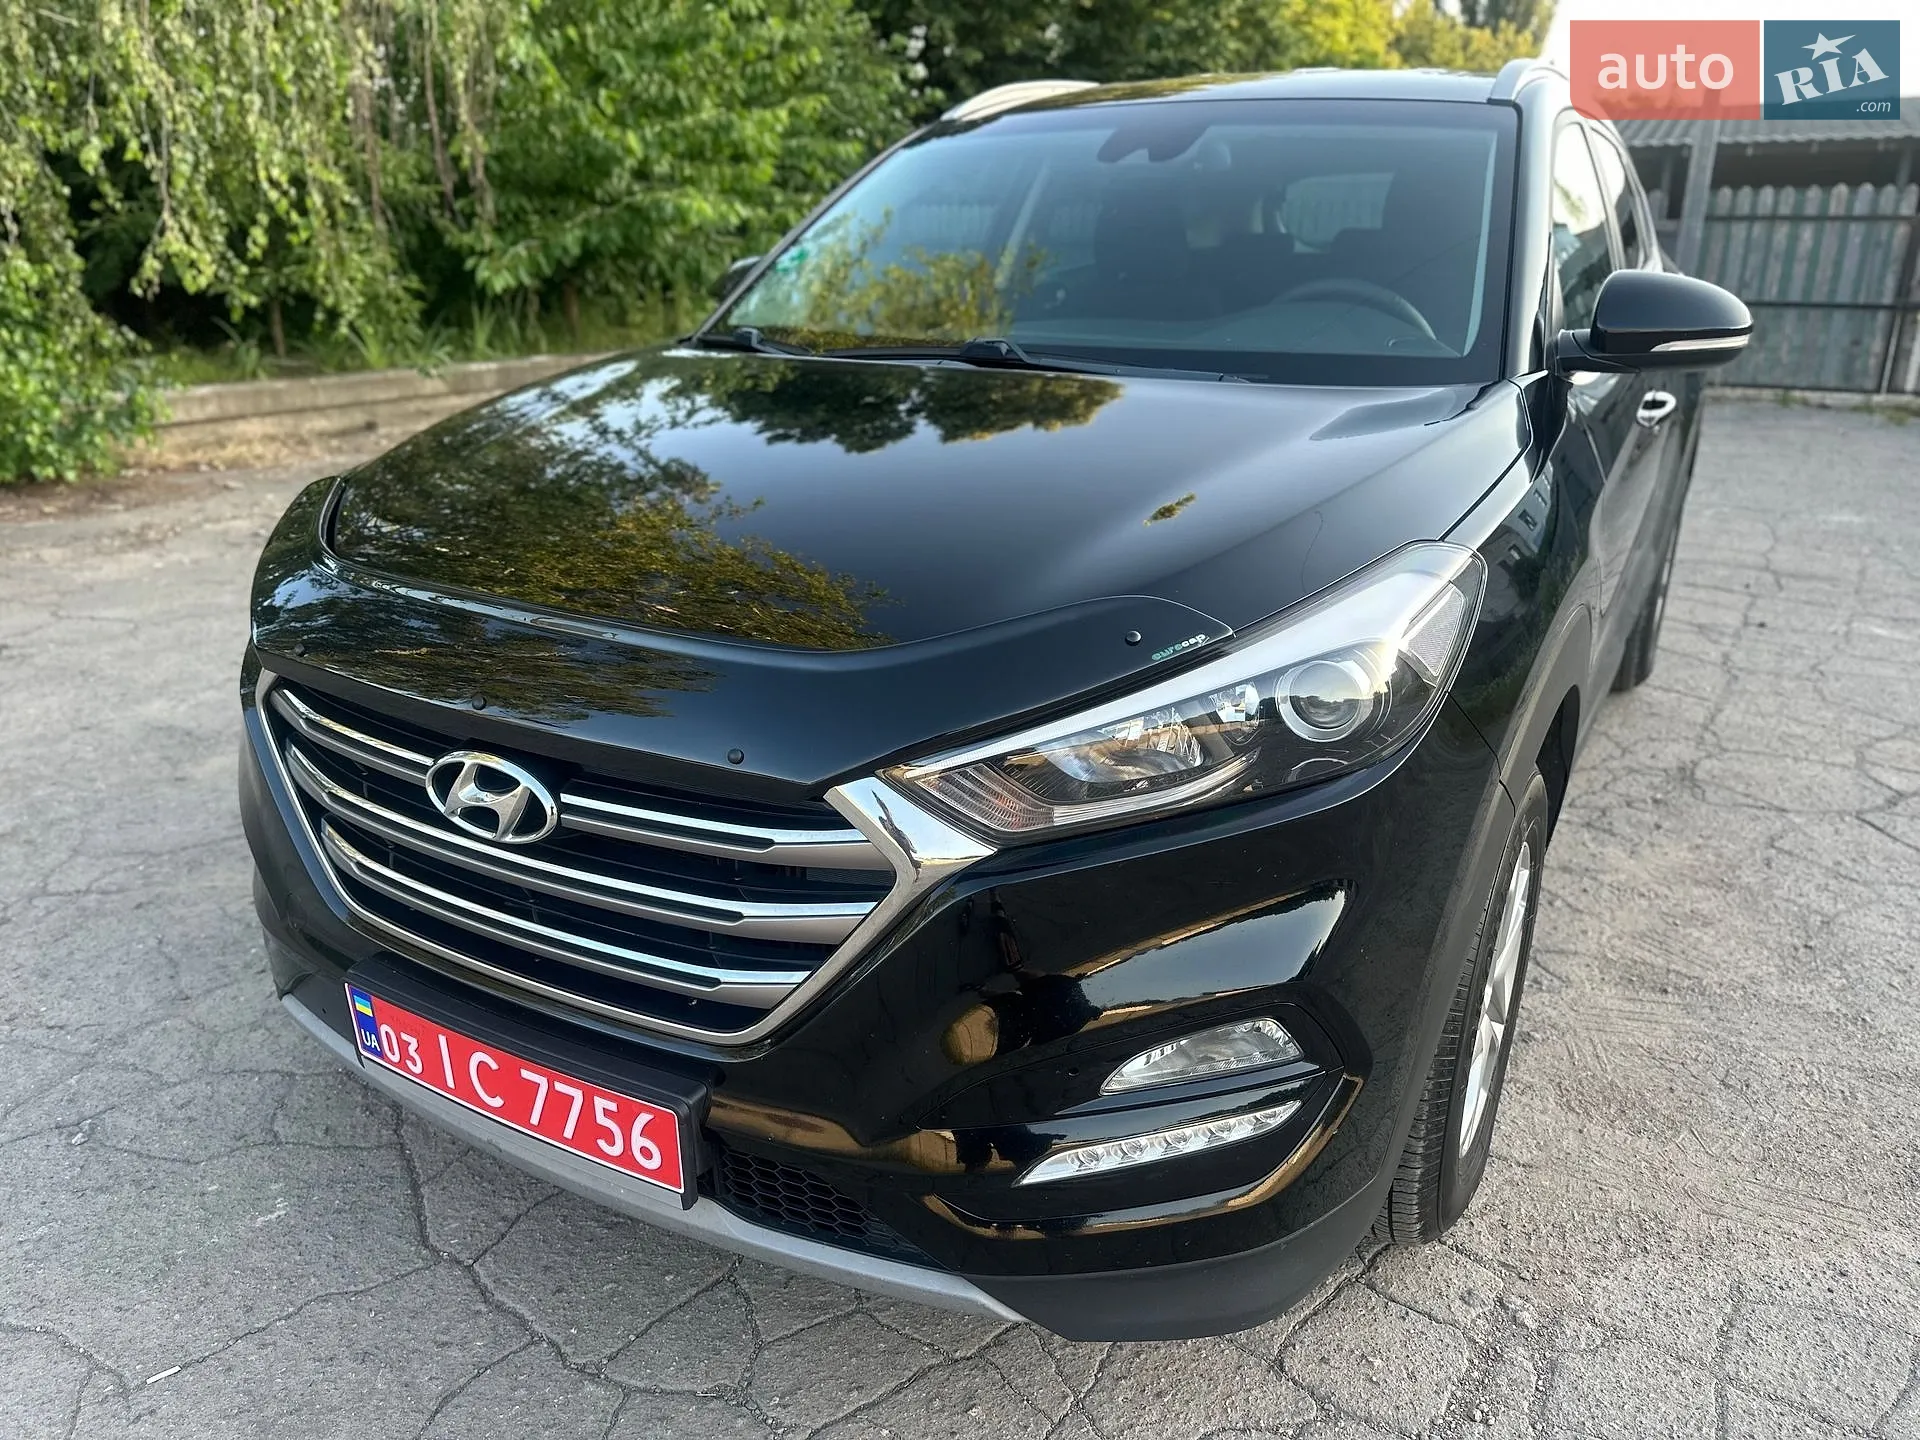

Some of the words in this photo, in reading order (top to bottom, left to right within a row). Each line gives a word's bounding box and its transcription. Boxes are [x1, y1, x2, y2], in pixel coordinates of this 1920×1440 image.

[361, 1028, 380, 1052] UA
[380, 1023, 423, 1074] 03
[520, 1068, 662, 1170] 7756
